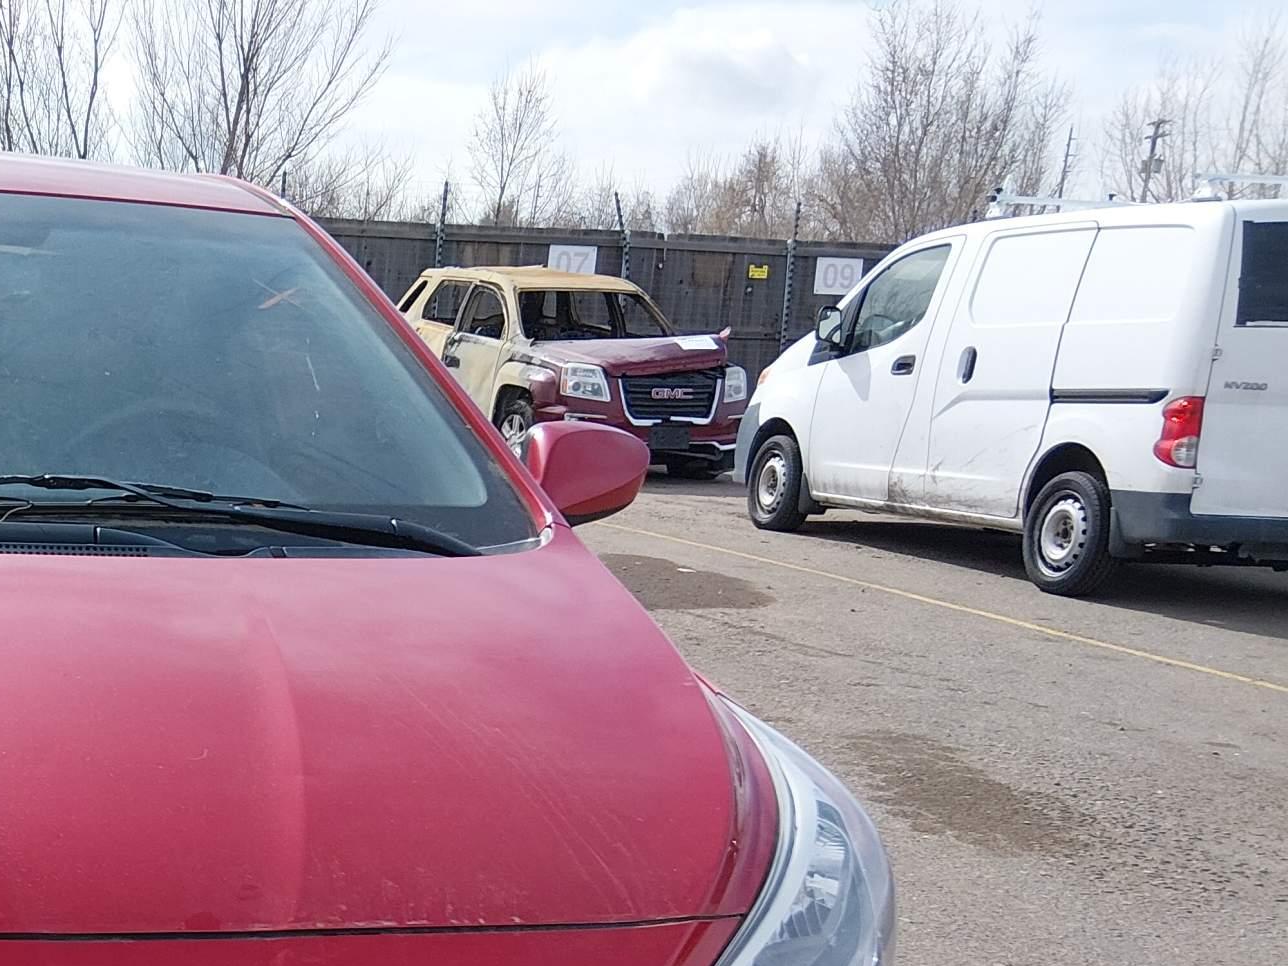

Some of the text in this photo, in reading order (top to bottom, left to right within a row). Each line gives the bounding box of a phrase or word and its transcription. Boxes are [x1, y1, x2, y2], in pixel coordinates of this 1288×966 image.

[555, 250, 590, 273] 07
[822, 263, 855, 290] 09
[651, 387, 694, 400] GMC
